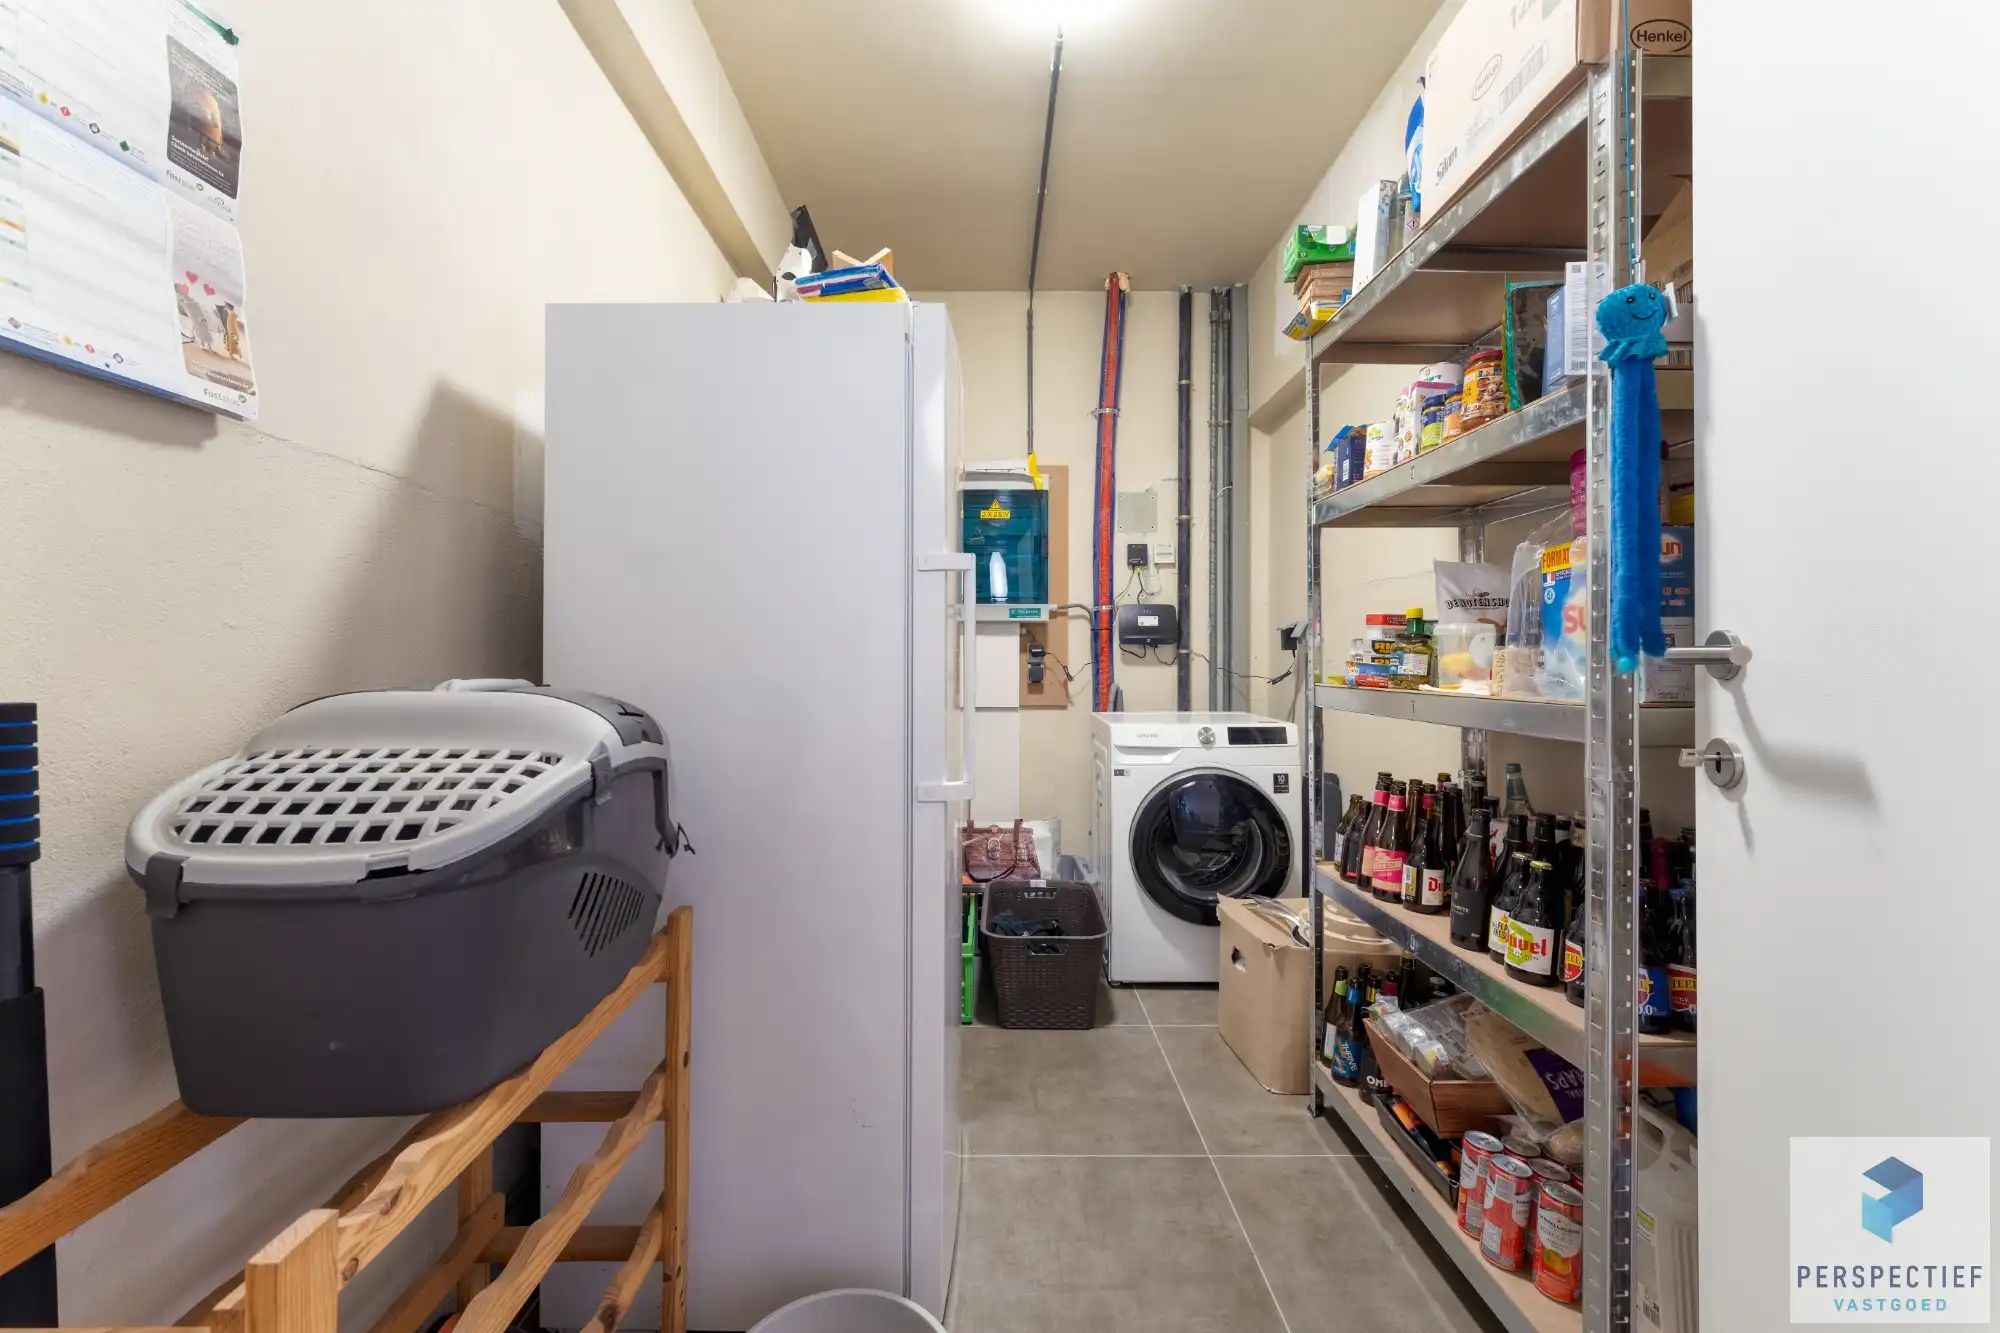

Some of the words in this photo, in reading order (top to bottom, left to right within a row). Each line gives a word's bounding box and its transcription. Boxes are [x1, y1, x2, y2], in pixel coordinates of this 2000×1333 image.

[1636, 30, 1687, 42] Henkel
[1659, 542, 1682, 555] un
[1542, 547, 1571, 570] FORMAT
[1460, 597, 1510, 608] NOTENSHO
[1428, 877, 1443, 891] Du
[1341, 1041, 1359, 1072] THRIVE
[1366, 1075, 1389, 1088] OME
